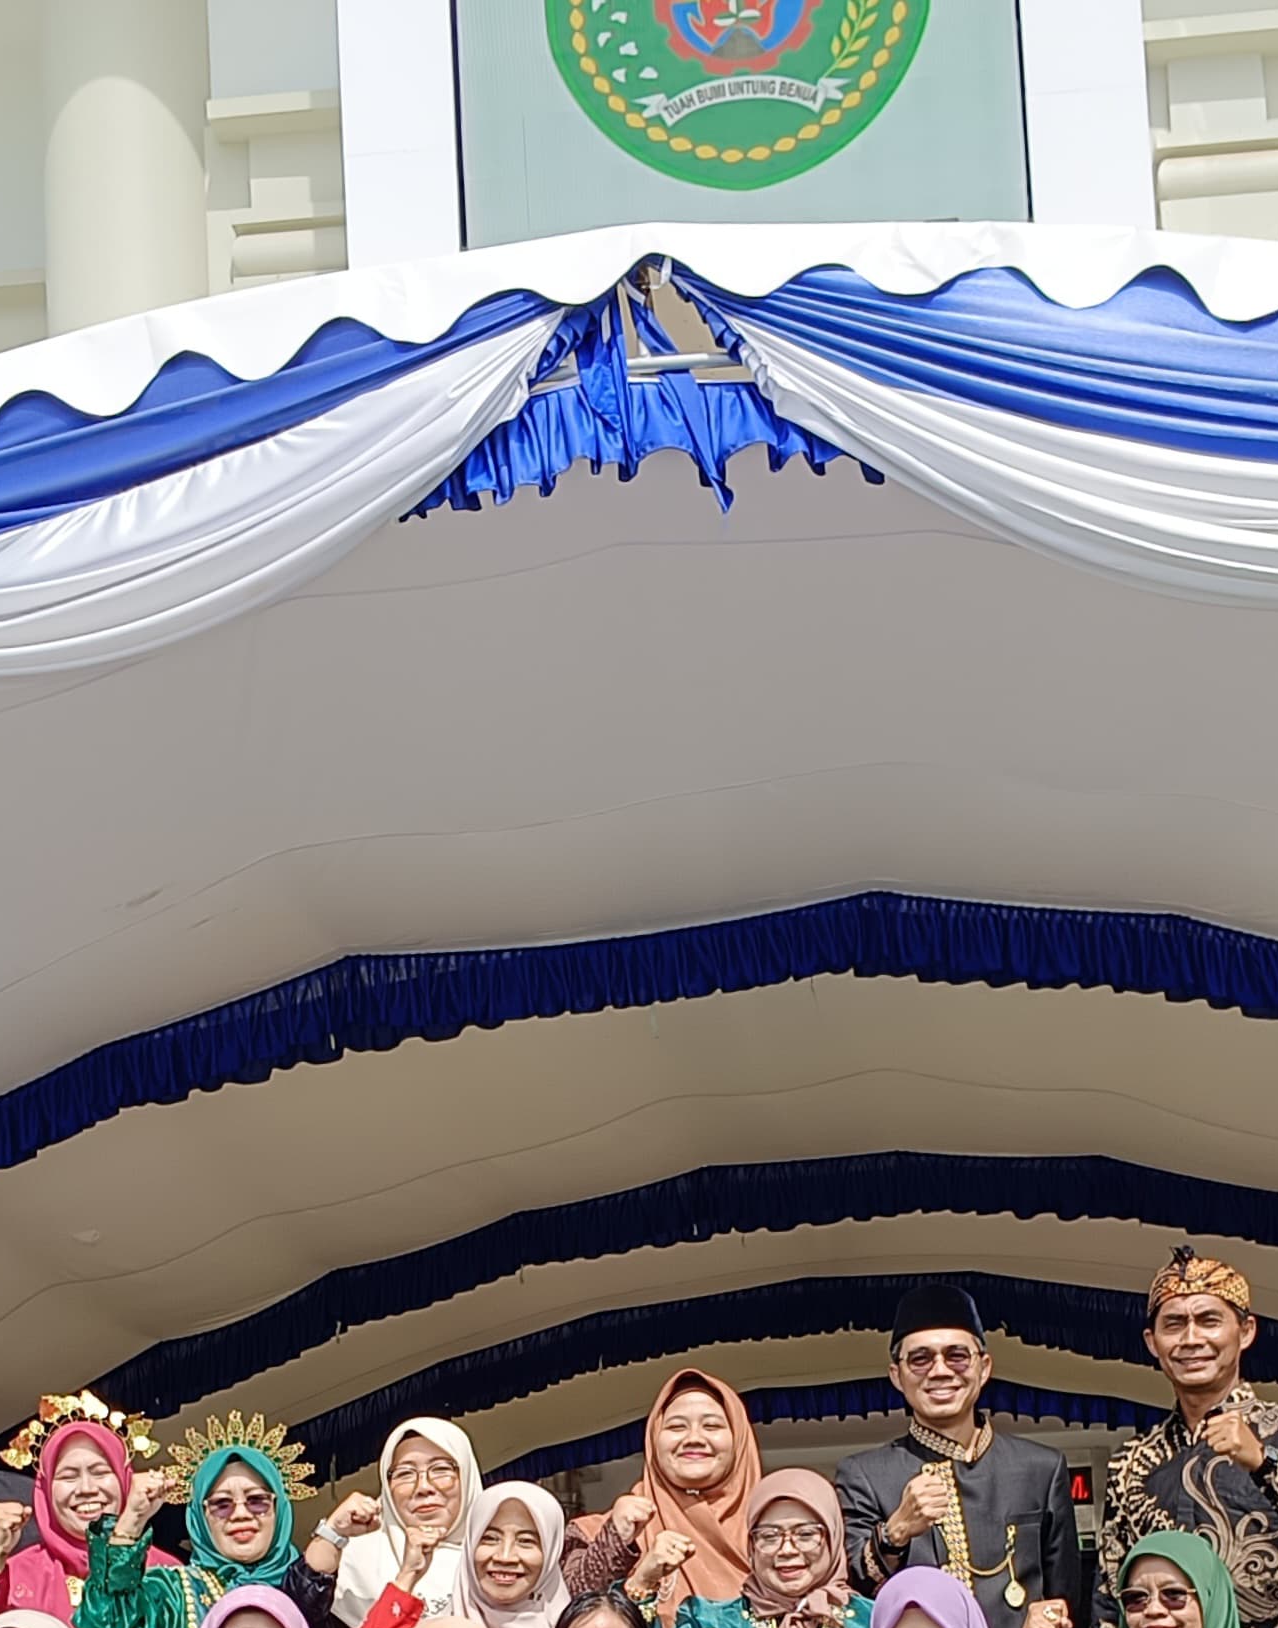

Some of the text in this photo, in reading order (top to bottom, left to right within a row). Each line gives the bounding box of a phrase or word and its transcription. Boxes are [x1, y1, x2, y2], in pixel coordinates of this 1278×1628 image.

[663, 79, 819, 120] TUAH BUMI UNTUNG BENUA
